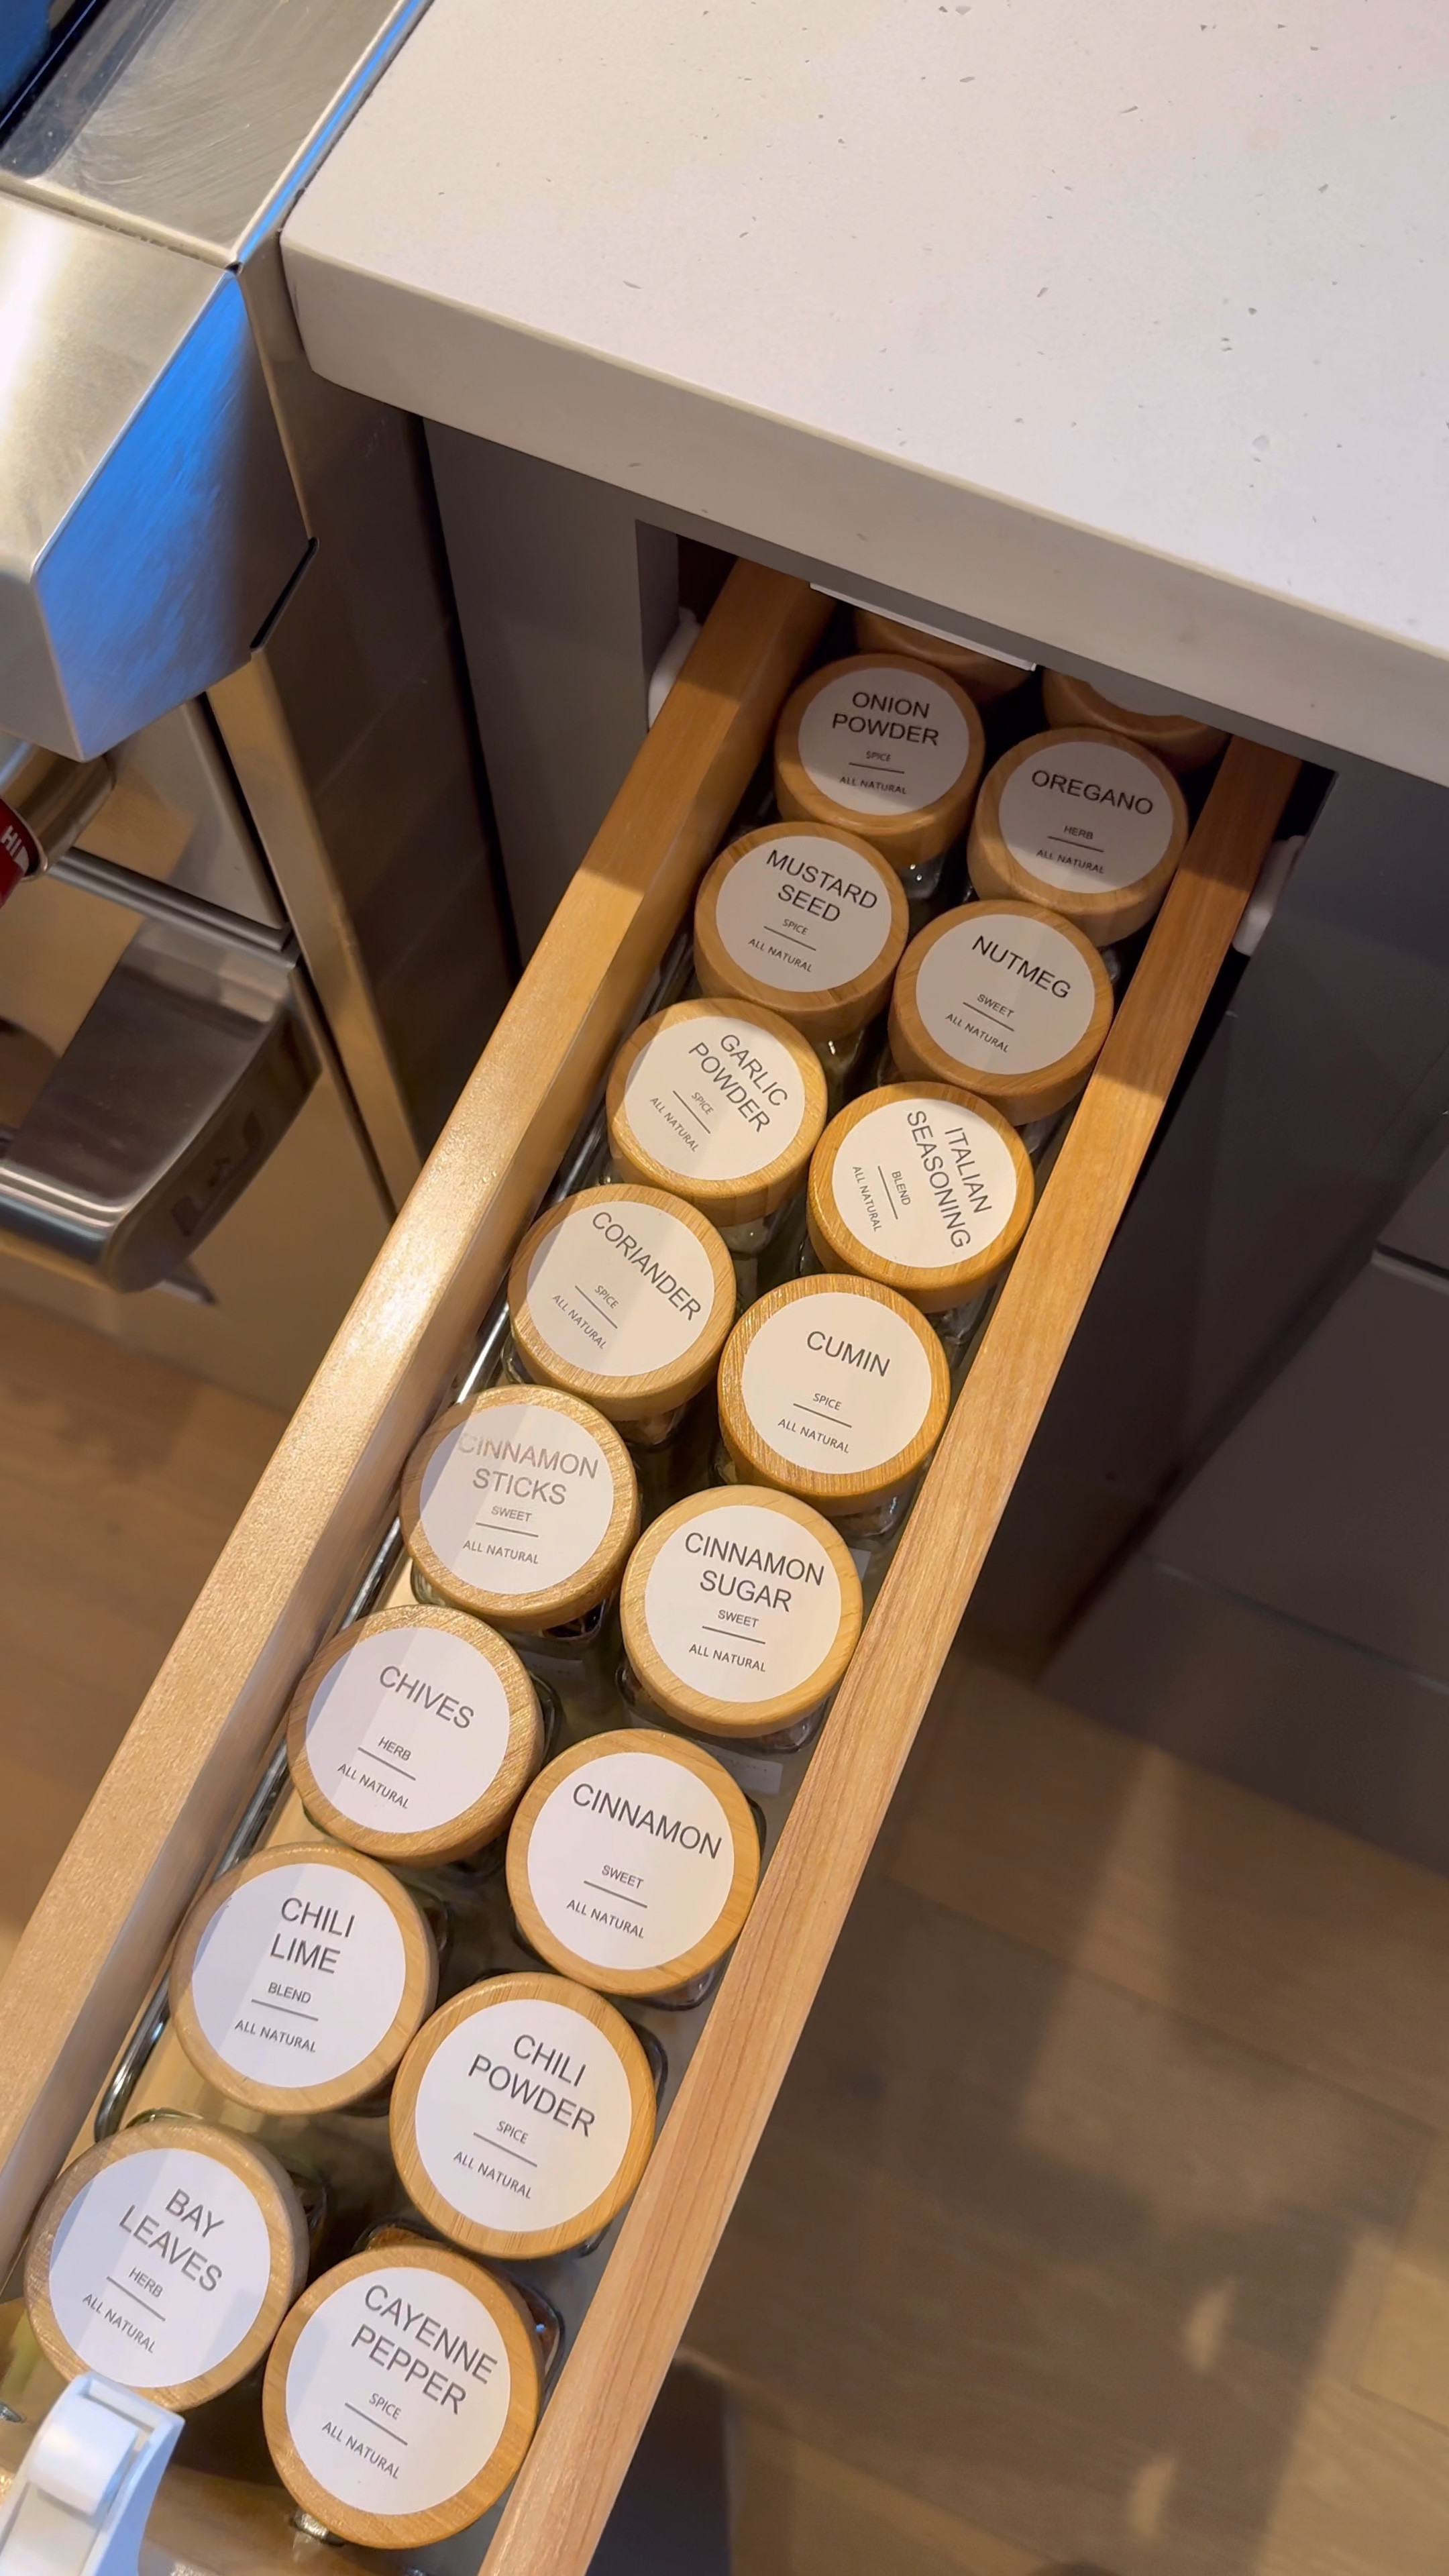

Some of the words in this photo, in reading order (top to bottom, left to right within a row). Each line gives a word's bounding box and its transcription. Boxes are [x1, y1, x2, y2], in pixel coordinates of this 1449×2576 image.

[852, 692, 930, 718] ONION
[832, 713, 939, 746] POWDER
[866, 751, 892, 762] SPICE
[839, 776, 857, 787] ALL
[860, 781, 907, 794] NATURAL
[1031, 769, 1154, 815] OREGANO
[1063, 825, 1093, 839] HERB
[766, 849, 877, 909] MUSTARD
[1036, 849, 1054, 861] ALL
[1057, 854, 1104, 873] NATURAL
[778, 885, 841, 923] SEED
[782, 918, 808, 936] SPICE
[748, 938, 765, 953] ALL
[768, 945, 812, 972] NATURAL
[971, 935, 1071, 999] NUTMEG
[977, 994, 1014, 1018] SWEET
[945, 1013, 963, 1028] ALL
[965, 1021, 1009, 1053] NATURAL
[689, 1042, 771, 1132] POWDER
[720, 1034, 788, 1107] GARLIC
[691, 1091, 714, 1115] SPICE
[650, 1097, 663, 1114] ALL
[663, 1112, 699, 1152] NATURAL
[891, 1171, 912, 1205] BLEND
[907, 1110, 971, 1248] SEASONING
[945, 1127, 992, 1214] ITALIAN
[852, 1166, 863, 1183] ALL
[859, 1184, 882, 1232] NATURAL
[592, 1212, 702, 1321] CORIANDER
[594, 1285, 619, 1309] SPICE
[552, 1294, 569, 1311] ALL
[568, 1308, 607, 1350] NATURAL
[807, 1331, 891, 1377] CUMIN
[813, 1393, 843, 1411] SPICE
[458, 1432, 600, 1479] CINNAMON
[777, 1418, 797, 1433] ALL
[800, 1426, 850, 1454] NATURAL
[473, 1468, 566, 1505] STICKS
[491, 1505, 533, 1522] SWEET
[463, 1540, 482, 1553] ALL
[486, 1545, 539, 1564] NATURAL
[685, 1532, 825, 1586] CINNAMON
[700, 1570, 792, 1613] SUGAR
[718, 1609, 759, 1628] SWEET
[689, 1644, 709, 1658] ALL
[712, 1648, 766, 1672] NATURAL
[379, 1666, 474, 1730] CHIVES
[378, 1736, 412, 1762] HERB
[337, 1764, 356, 1779] ALL
[359, 1772, 409, 1809] NATURAL
[573, 1783, 722, 1860] CINNAMON
[601, 1865, 645, 1890] SWEET
[281, 1897, 356, 1938] CHILI
[567, 1899, 588, 1916] ALL
[590, 1908, 645, 1939] NATURAL
[270, 1933, 341, 1974] LIME
[268, 1982, 311, 2004] BLEND
[235, 2019, 257, 2035] ALL
[260, 2026, 317, 2053] NATURAL
[514, 2035, 587, 2087] CHILI
[468, 2054, 596, 2138] POWDER
[496, 2121, 529, 2145] SPICE
[453, 2151, 474, 2170] ALL
[478, 2163, 531, 2200] NATURAL
[165, 2188, 225, 2239] BAY
[118, 2205, 223, 2292] LEAVES
[128, 2267, 164, 2298] HERB
[83, 2293, 104, 2313] ALL
[105, 2306, 156, 2354] NATURAL
[364, 2284, 498, 2385] CAYENNE
[352, 2324, 467, 2415] PEPPER
[368, 2392, 402, 2420] SPICE
[322, 2420, 344, 2440] ALL
[345, 2434, 400, 2479] NATURAL
